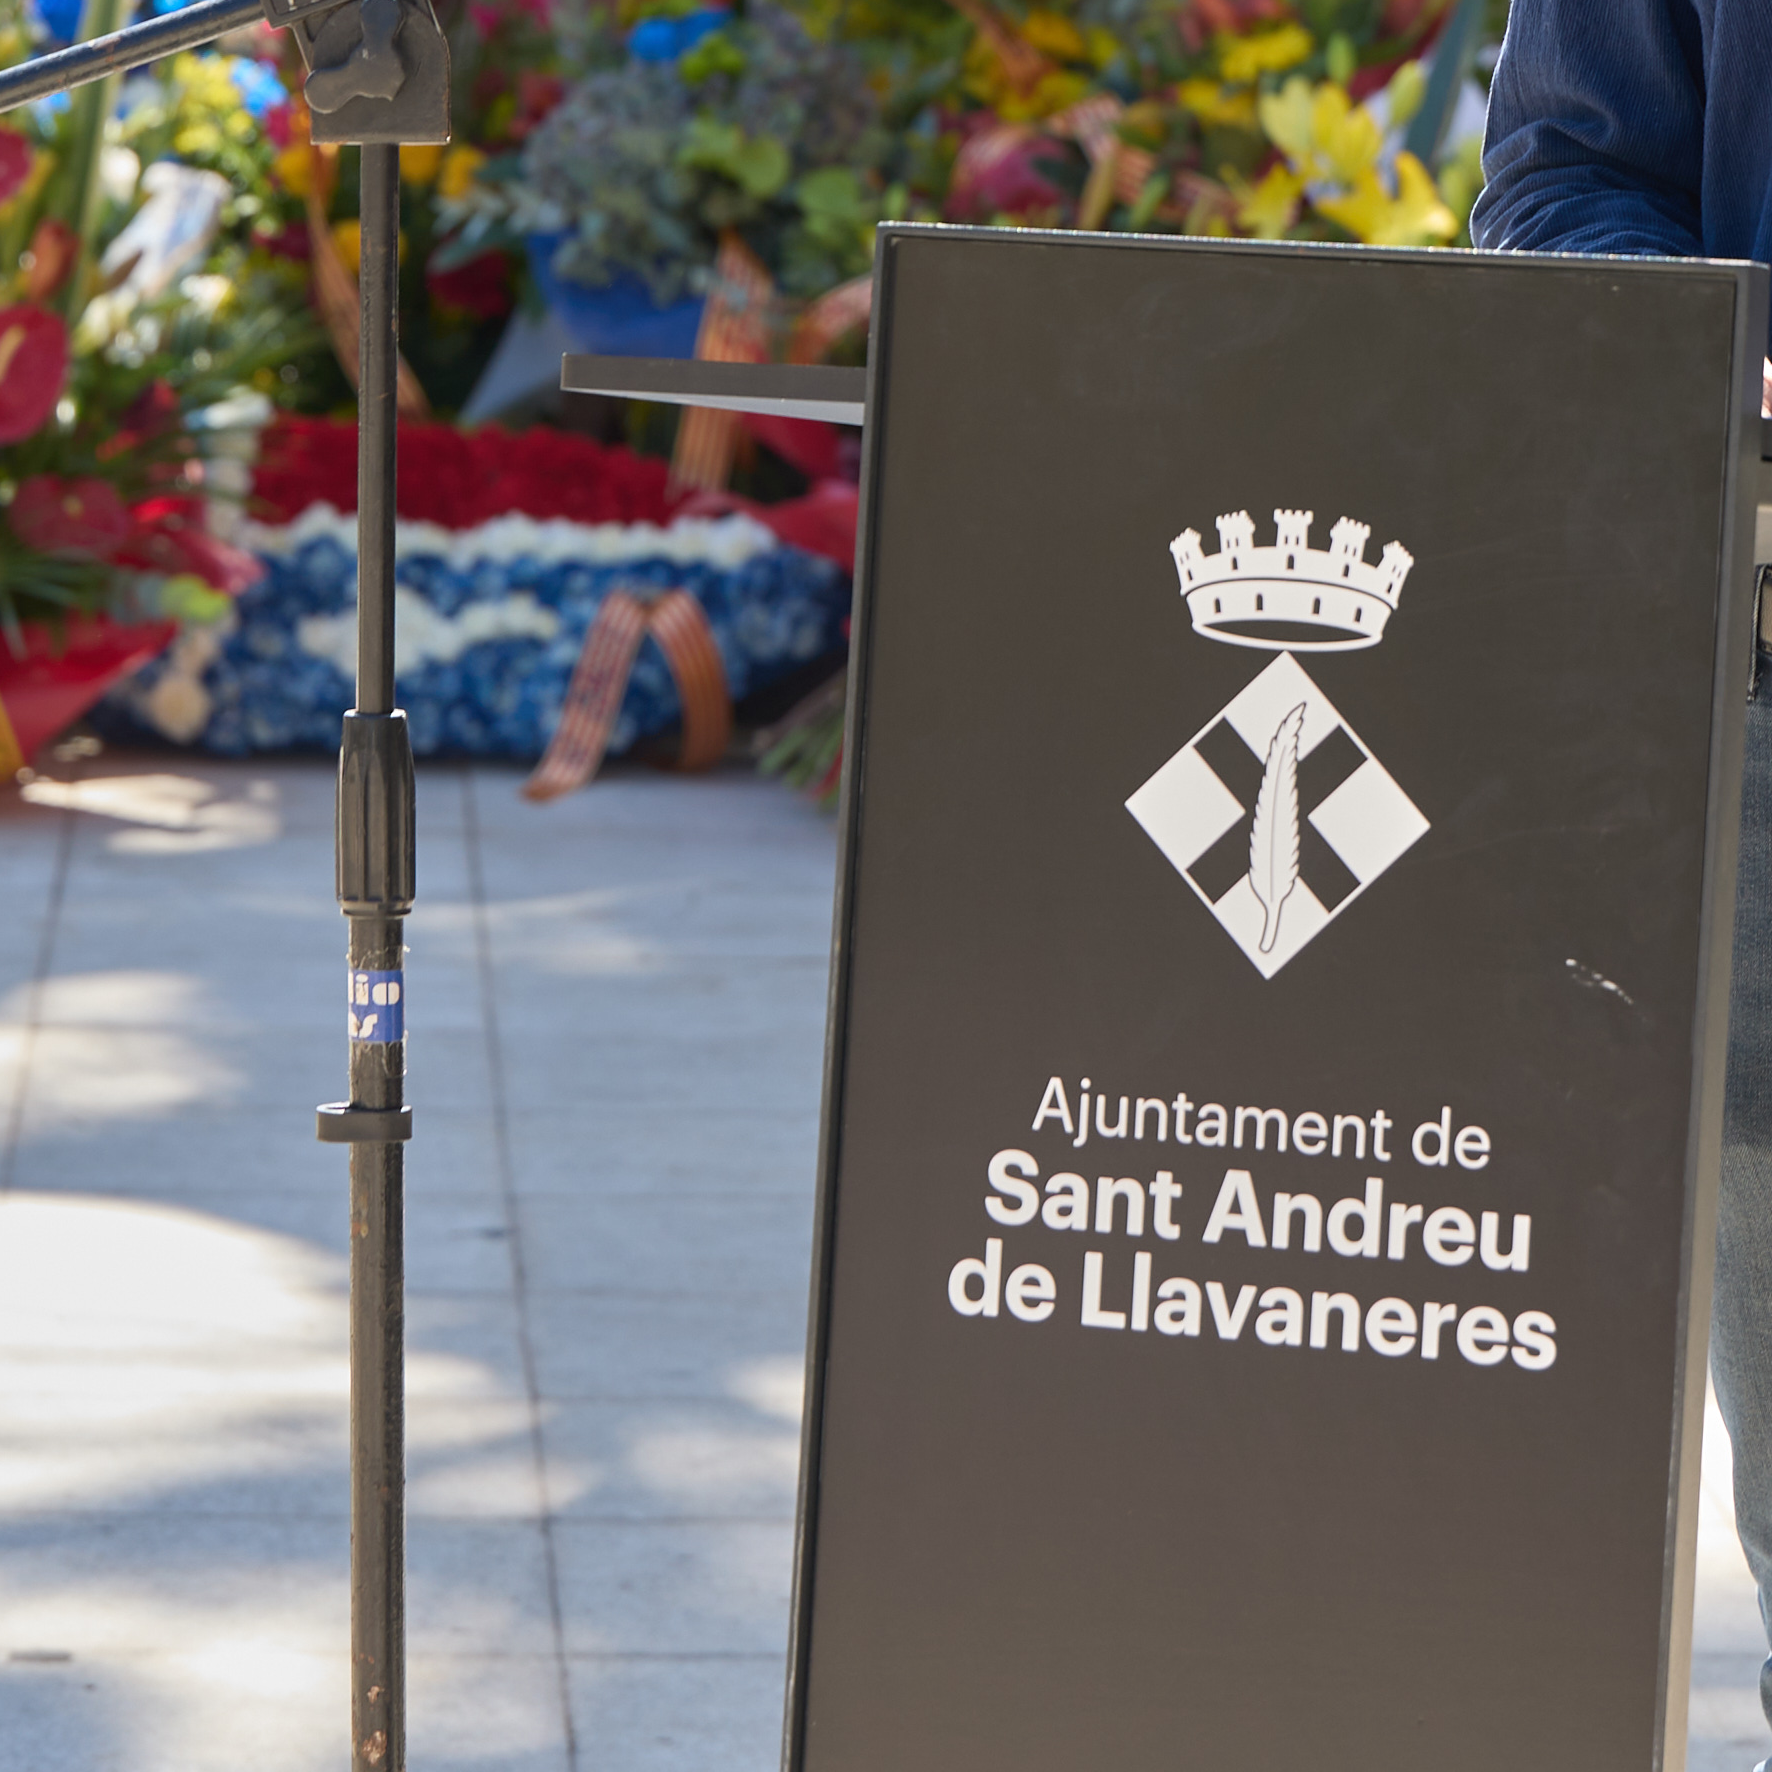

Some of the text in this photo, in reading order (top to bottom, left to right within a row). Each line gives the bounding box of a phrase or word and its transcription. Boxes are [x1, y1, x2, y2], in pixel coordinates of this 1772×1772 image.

[1031, 1076, 1491, 1170] Ajuntament de
[984, 1148, 1531, 1272] Sant Andreu
[947, 1237, 1557, 1371] de Llavaneres
